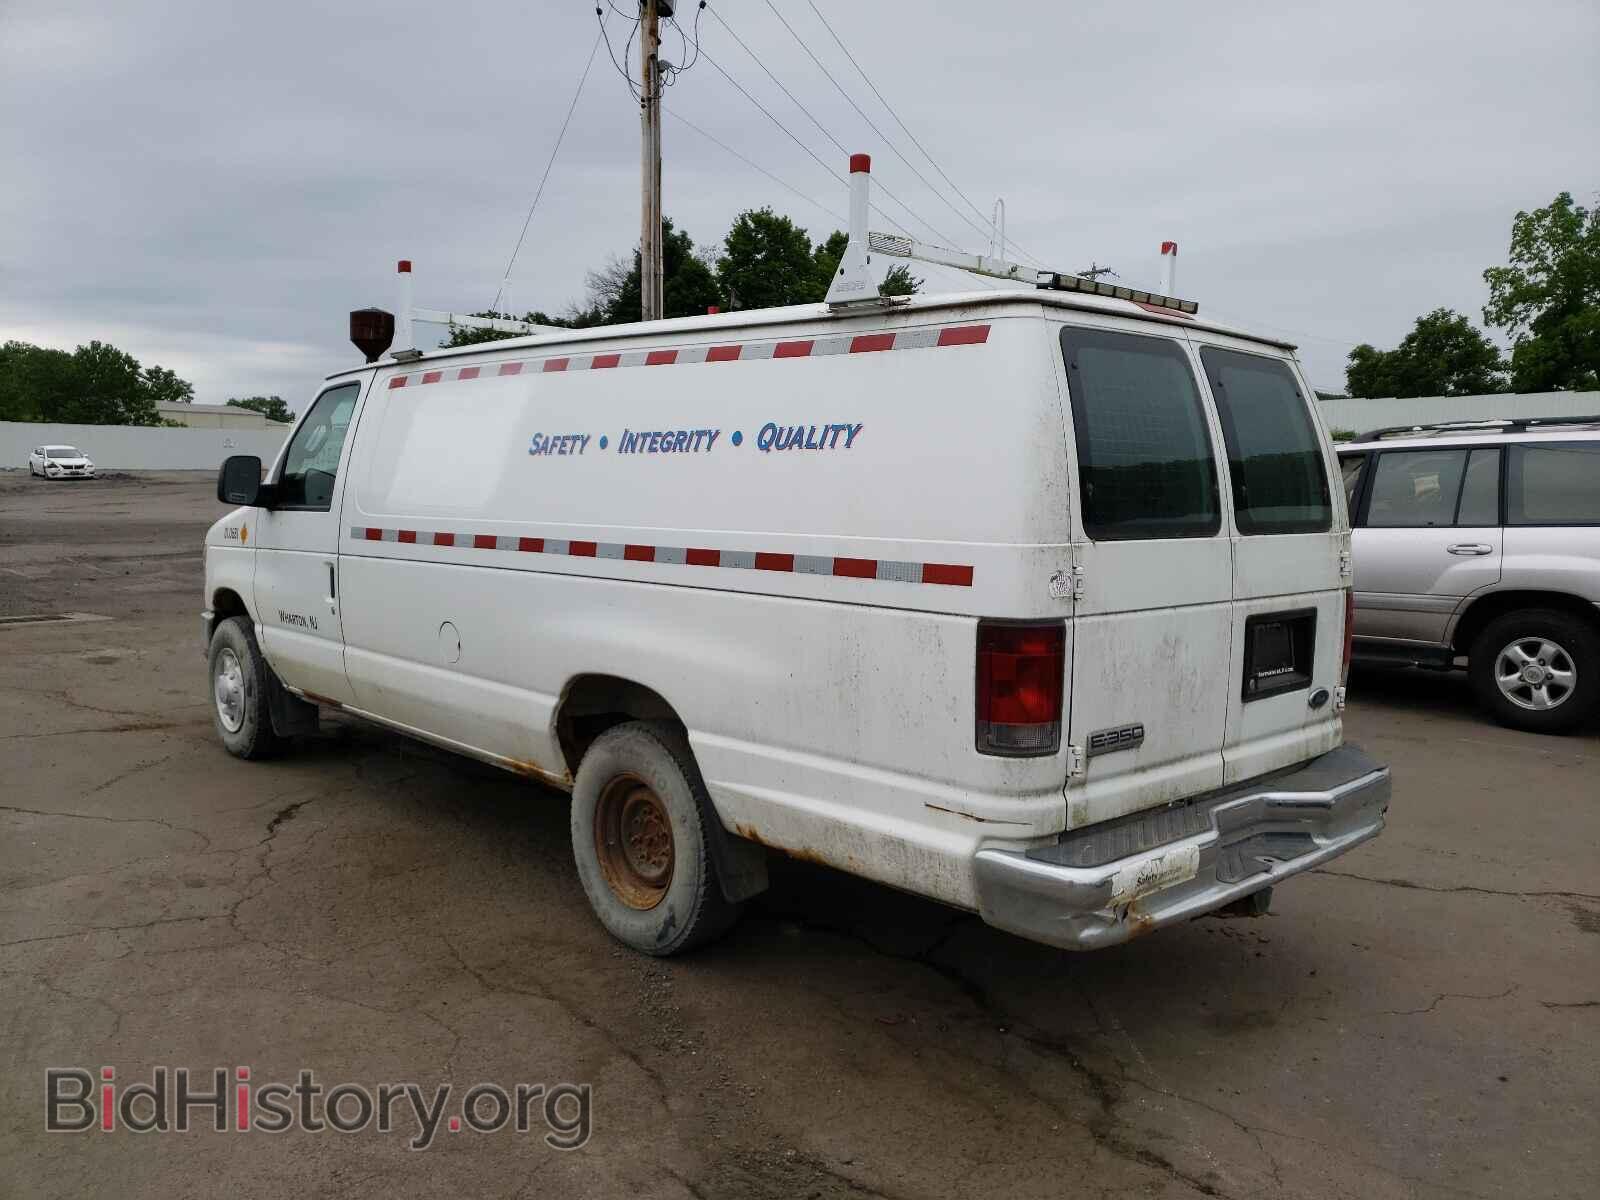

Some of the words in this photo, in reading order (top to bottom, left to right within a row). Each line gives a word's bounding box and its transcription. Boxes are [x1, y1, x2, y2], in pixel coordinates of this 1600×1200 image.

[528, 431, 591, 456] SAFETY
[617, 428, 721, 454] INTEGRITY
[756, 422, 863, 452] QUALITY
[309, 615, 318, 630] NJ
